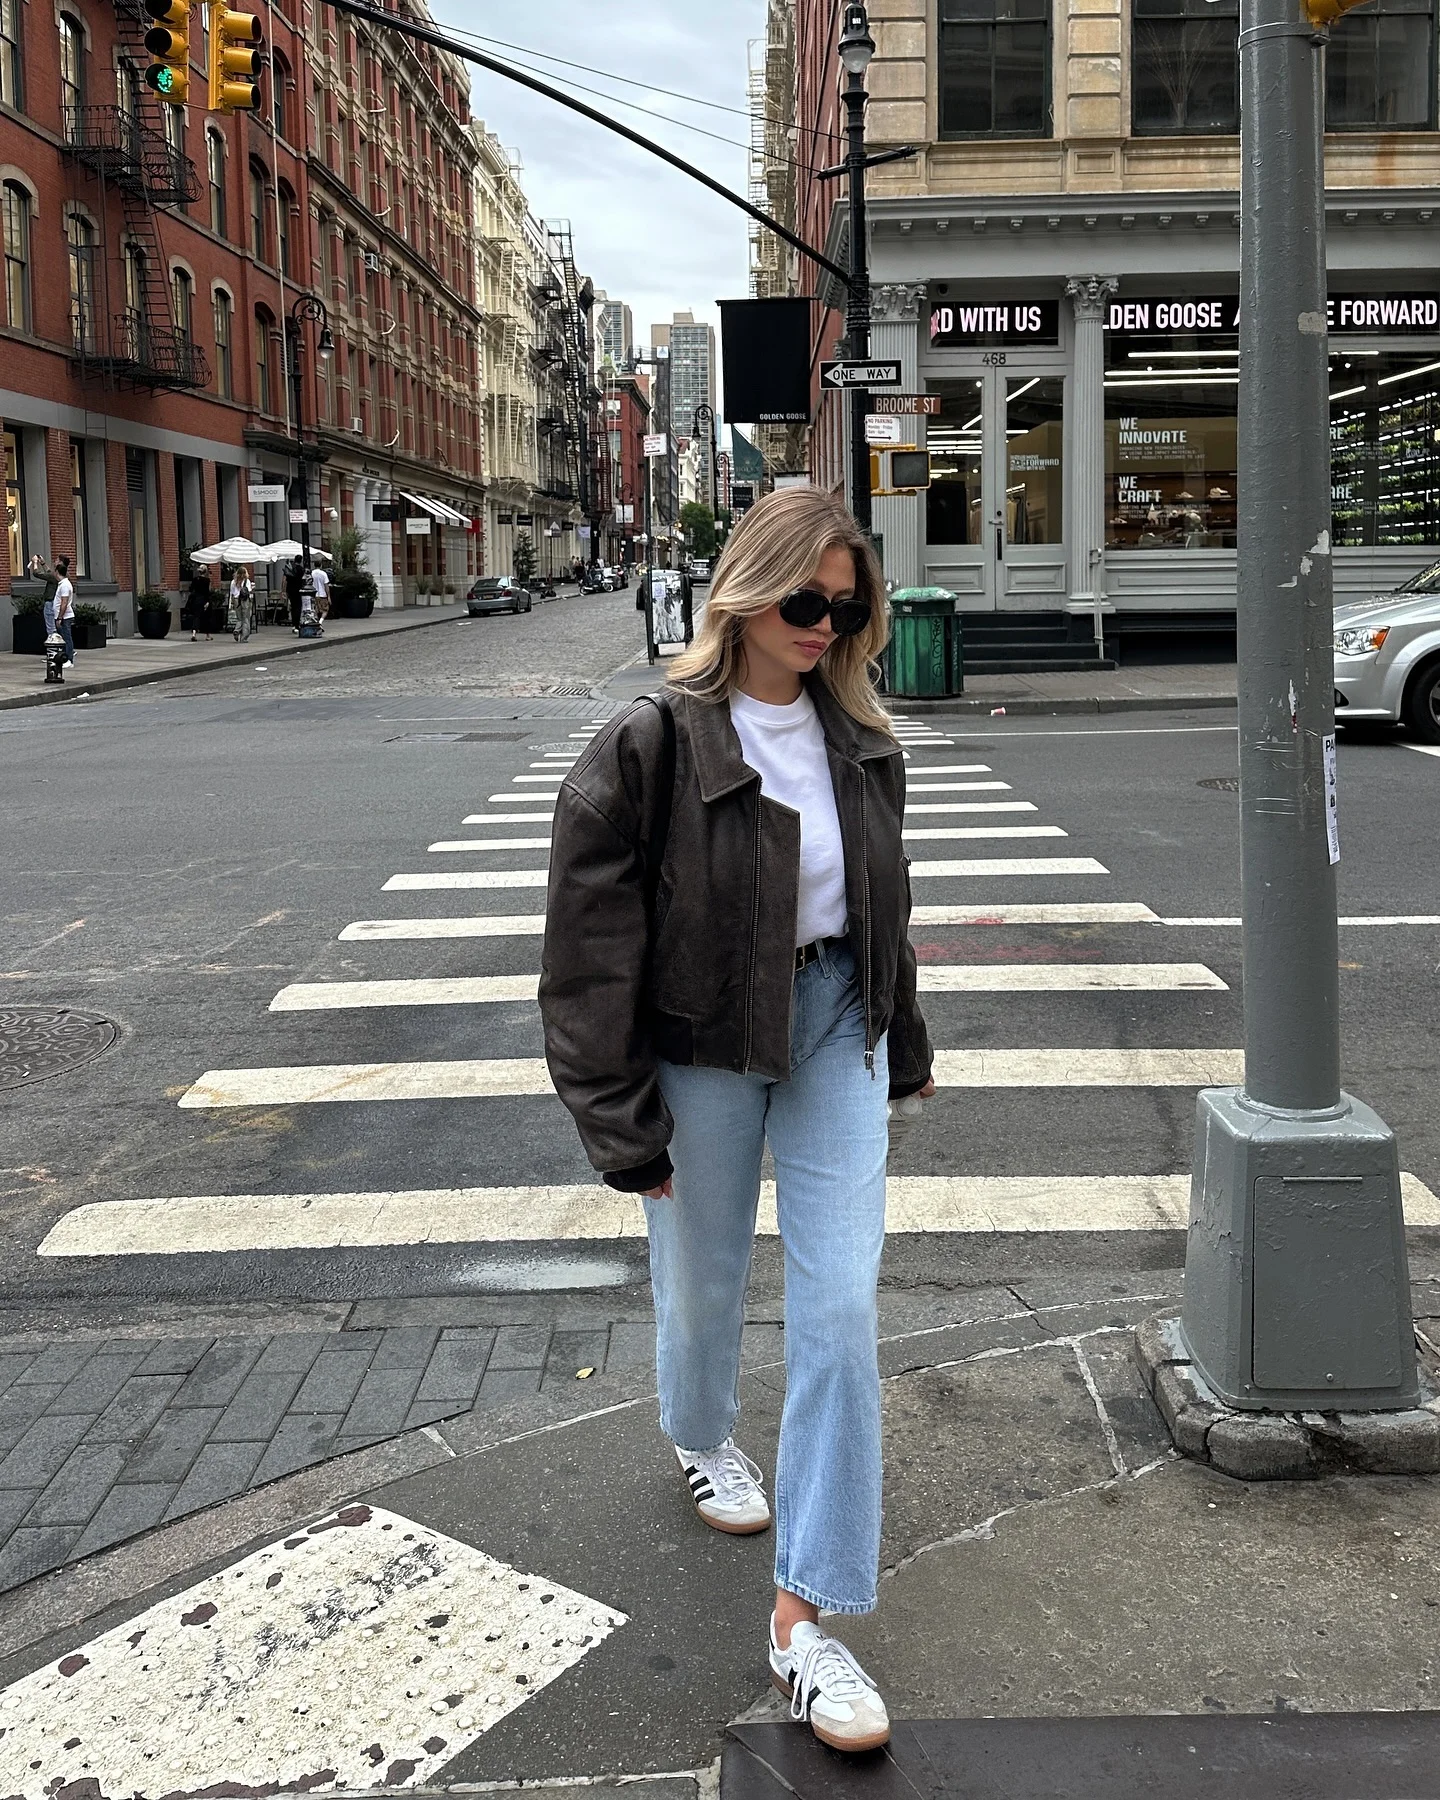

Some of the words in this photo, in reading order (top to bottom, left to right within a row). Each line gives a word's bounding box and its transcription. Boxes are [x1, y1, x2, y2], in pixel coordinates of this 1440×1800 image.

[960, 306, 1008, 332] WITH
[1015, 305, 1041, 331] US
[1102, 304, 1149, 330] DEN
[1156, 302, 1222, 329] GOOSE
[1340, 299, 1438, 326] FORWARD
[982, 352, 1006, 365] 468
[832, 369, 856, 380] ONE
[866, 368, 891, 380] WAY
[876, 397, 918, 413] BROOME
[923, 397, 936, 413] ST
[786, 412, 806, 420] GOOSE
[1119, 417, 1138, 430] WE
[1119, 430, 1187, 444] INNOVATE
[1119, 476, 1138, 489] WE
[1118, 490, 1162, 503] CRAFT
